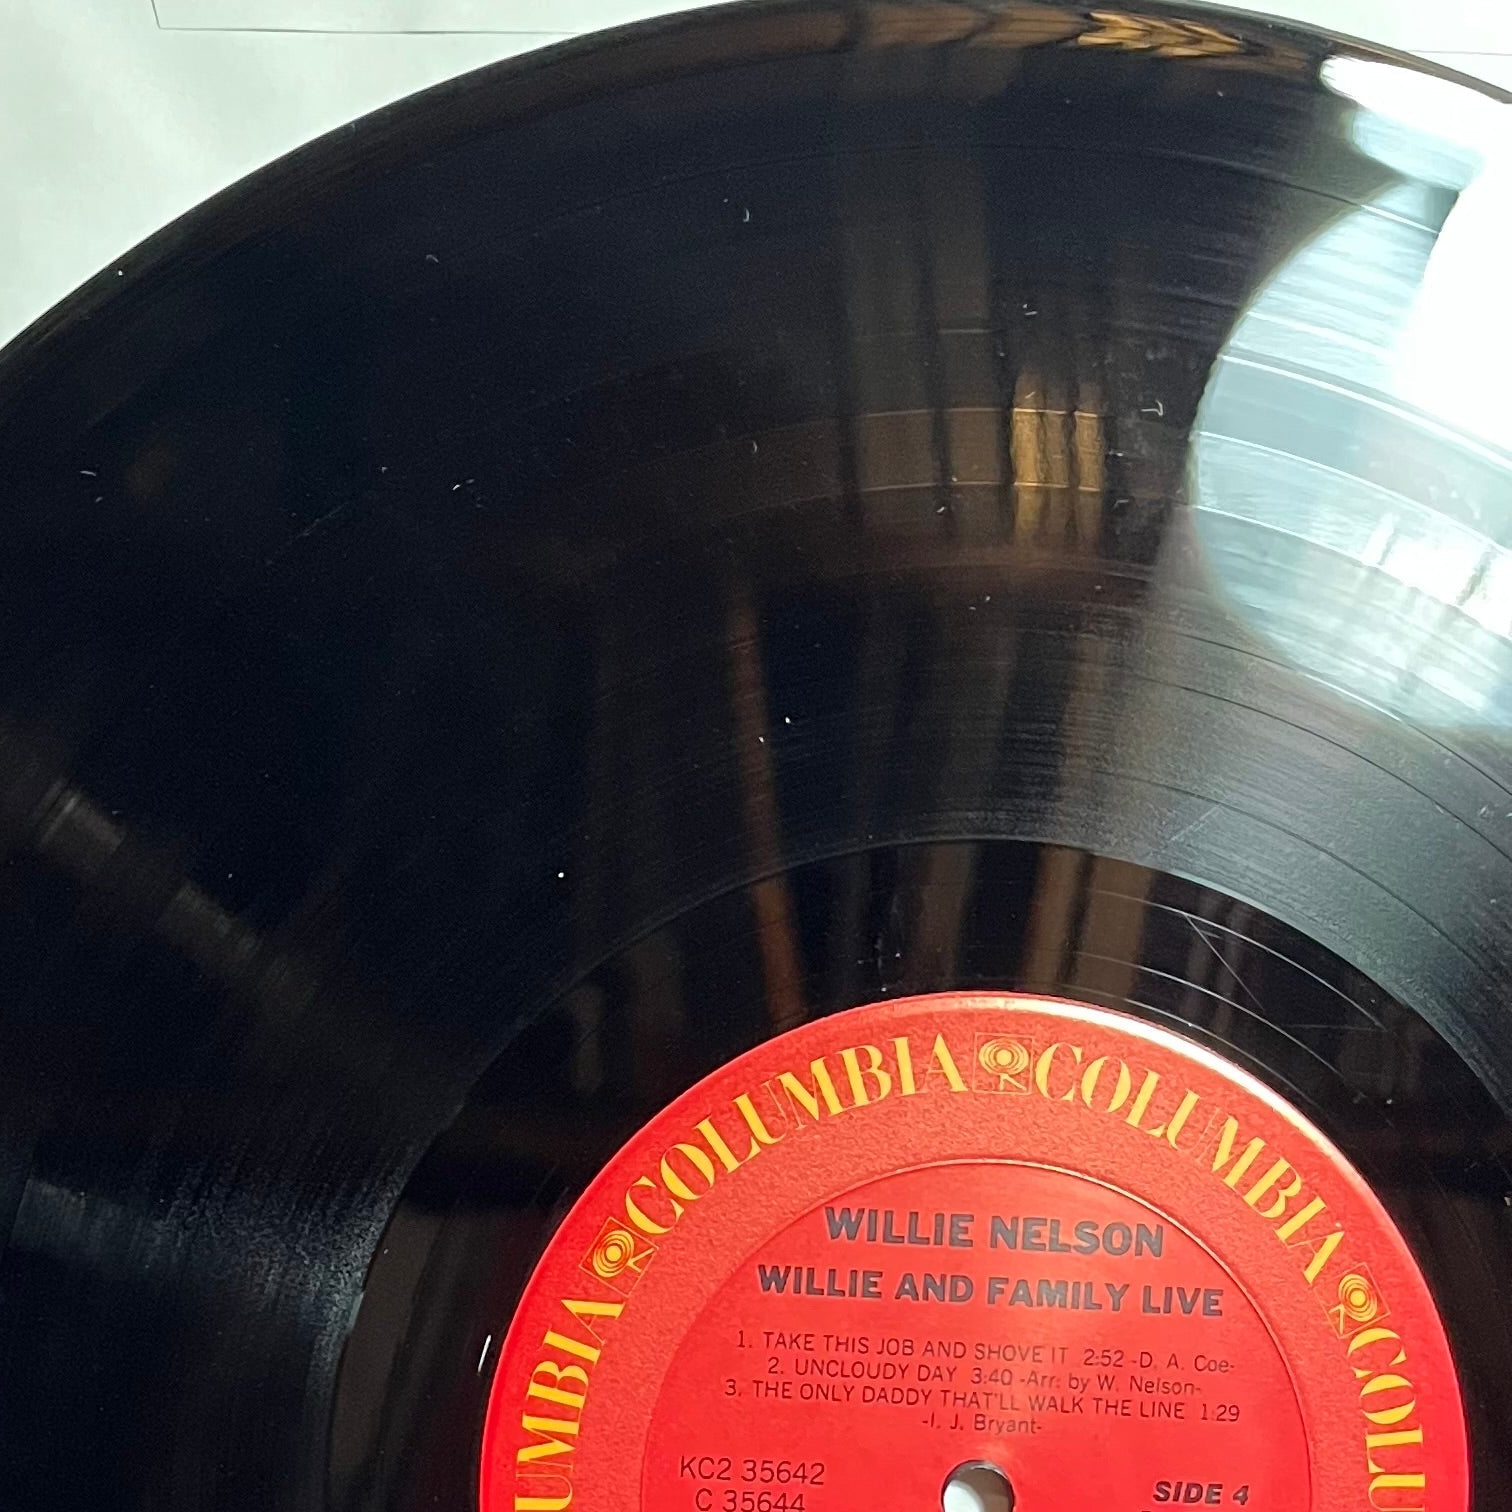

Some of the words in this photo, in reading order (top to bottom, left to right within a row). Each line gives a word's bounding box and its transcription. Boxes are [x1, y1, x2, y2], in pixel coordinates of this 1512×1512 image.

[625, 1036, 967, 1236] COLUMBIA
[1035, 1041, 1347, 1286] COLUMBIA
[824, 1206, 975, 1248] WILLIE
[989, 1215, 1164, 1258] NELSON
[757, 1263, 884, 1300] WILLIE
[894, 1272, 974, 1303] AND
[986, 1276, 1130, 1313] FAMILY
[1141, 1284, 1224, 1317] LIVE
[762, 1331, 816, 1352] TAKE
[822, 1334, 870, 1355] THIS
[876, 1337, 915, 1357] JOB
[922, 1340, 967, 1360] AND
[974, 1342, 1046, 1364] SHOVE
[1051, 1346, 1069, 1364] IT
[795, 1358, 910, 1380] UNCLOUDY
[917, 1363, 958, 1383] DAY
[1068, 1372, 1090, 1394] by
[751, 1379, 793, 1400] THE
[799, 1382, 855, 1402] ONLY
[861, 1385, 933, 1406] DADDY
[939, 1389, 1020, 1411] THAT'LL
[1028, 1394, 1084, 1414] WALK
[1092, 1397, 1133, 1417] THE
[1139, 1401, 1185, 1420] LINE
[973, 1413, 1043, 1436] Bryant-
[680, 1455, 732, 1481] KC2
[740, 1459, 825, 1486] 35642
[695, 1487, 713, 1512] C
[1152, 1480, 1224, 1505] SIDE
[1232, 1484, 1250, 1507] 4
